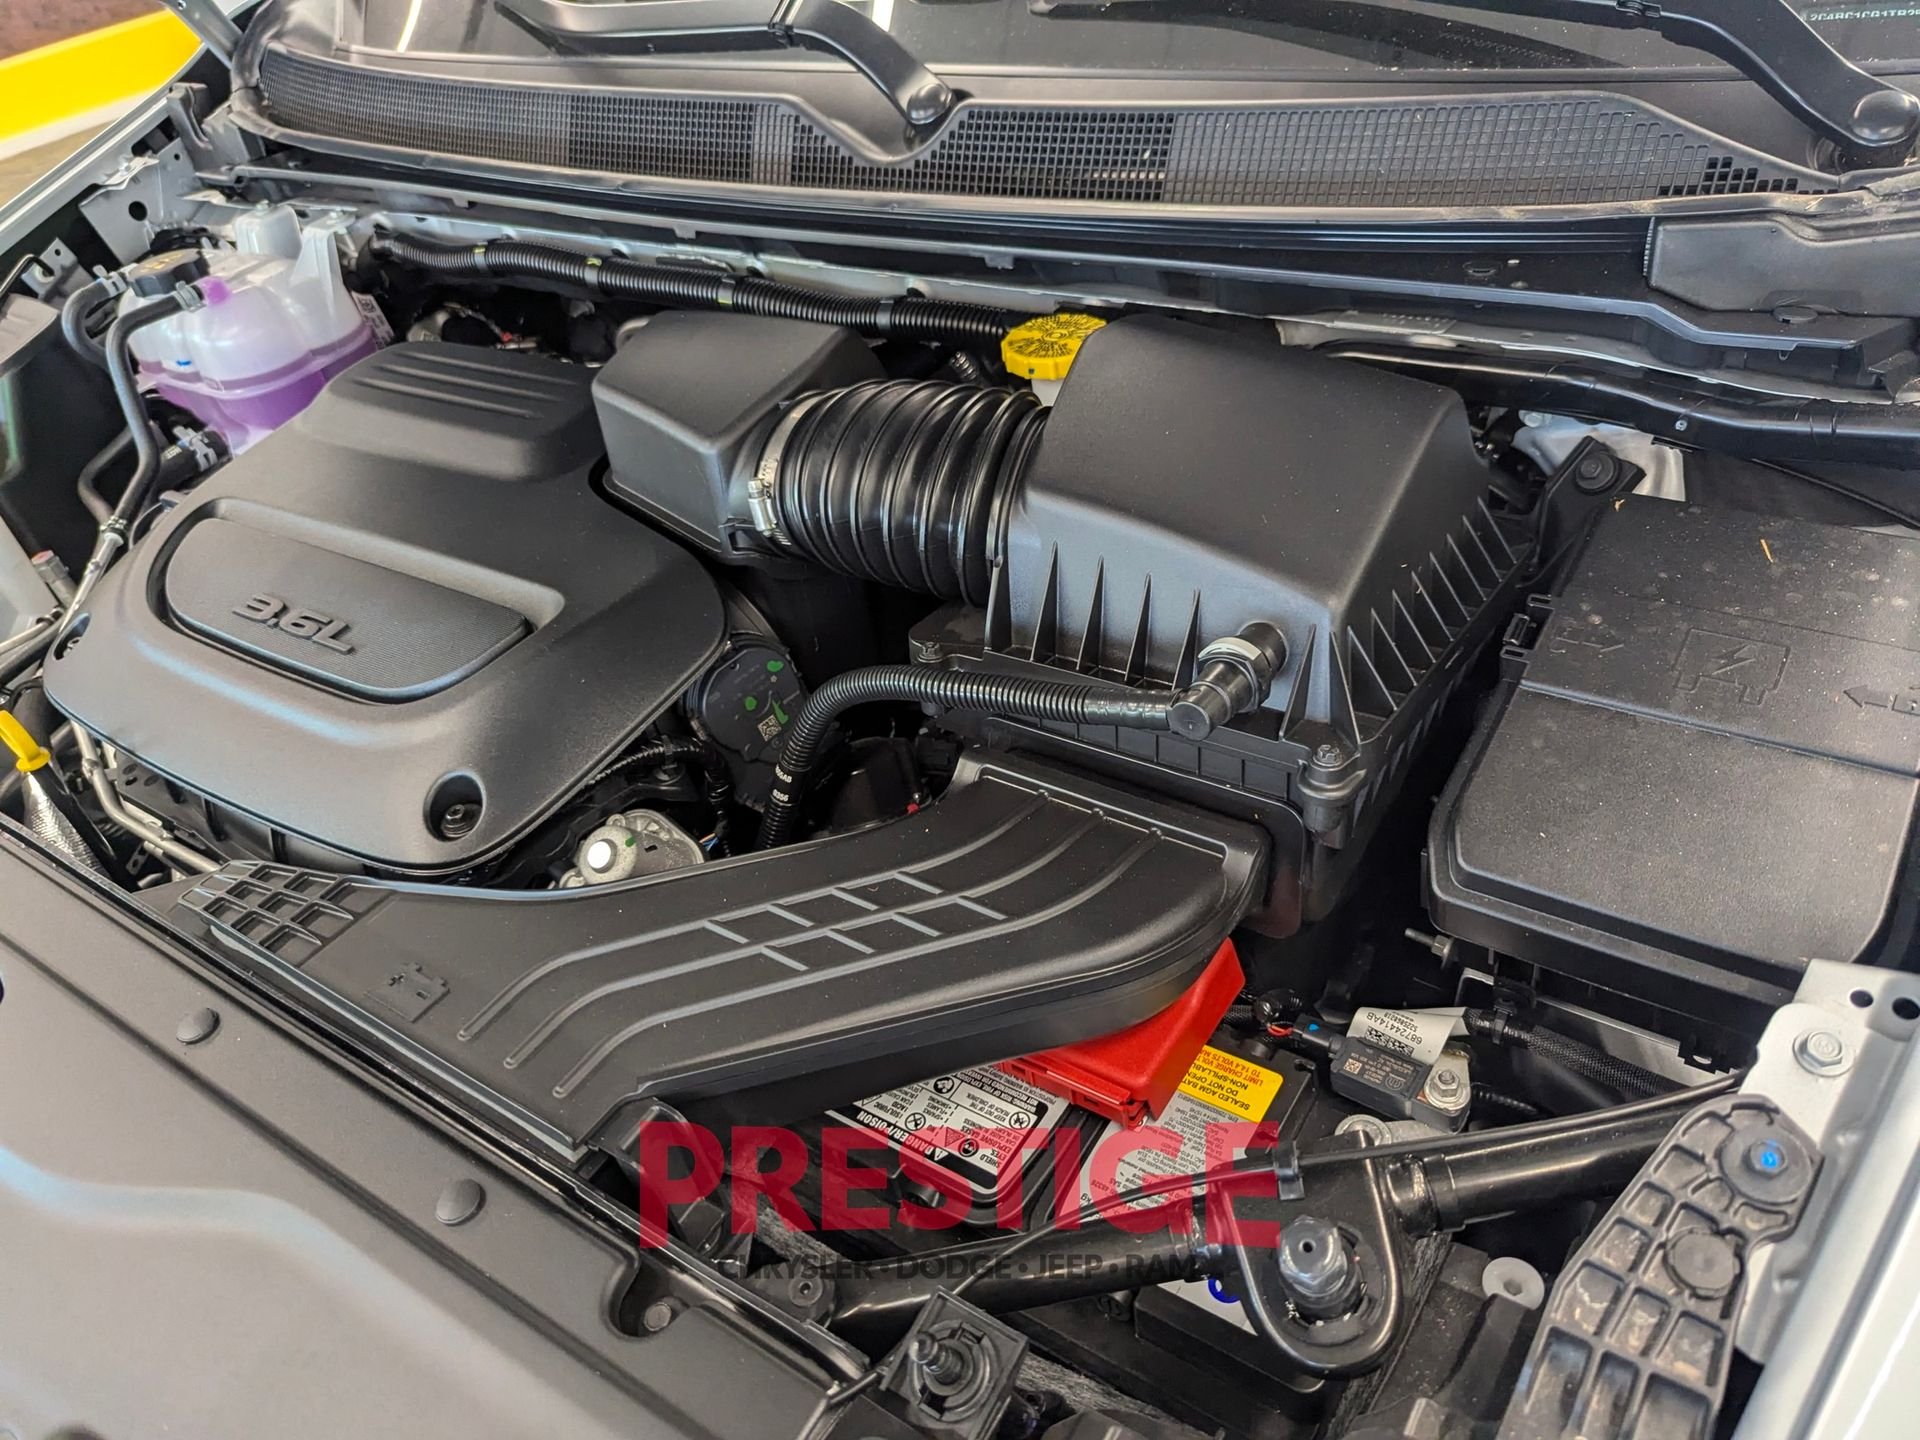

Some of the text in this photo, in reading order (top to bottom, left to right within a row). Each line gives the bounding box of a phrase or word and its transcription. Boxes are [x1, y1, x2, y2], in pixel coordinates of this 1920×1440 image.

[231, 592, 357, 656] 3.6L
[1364, 1010, 1423, 1046] 68724414AB
[1210, 1052, 1234, 1067] VOLTS
[1233, 1061, 1250, 1073] 14.4
[1190, 1061, 1249, 1091] NON-SPILLABL
[1213, 1061, 1243, 1079] CHARGE
[1250, 1068, 1261, 1078] TO
[1206, 1078, 1225, 1091] NOT
[1242, 1072, 1263, 1087] LIMIT
[990, 1078, 1028, 1102] RECOMMENDED
[1197, 1083, 1218, 1097] AGM
[1224, 1086, 1239, 1097] DO
[872, 1100, 901, 1119] SULFURIC
[890, 1099, 906, 1112] ACID
[1216, 1091, 1251, 1111] SEALED
[855, 1109, 935, 1155] DANGER/POISON
[959, 1124, 1012, 1154] EXPLOSIVE GASES
[978, 1152, 1002, 1168] SHIELD
